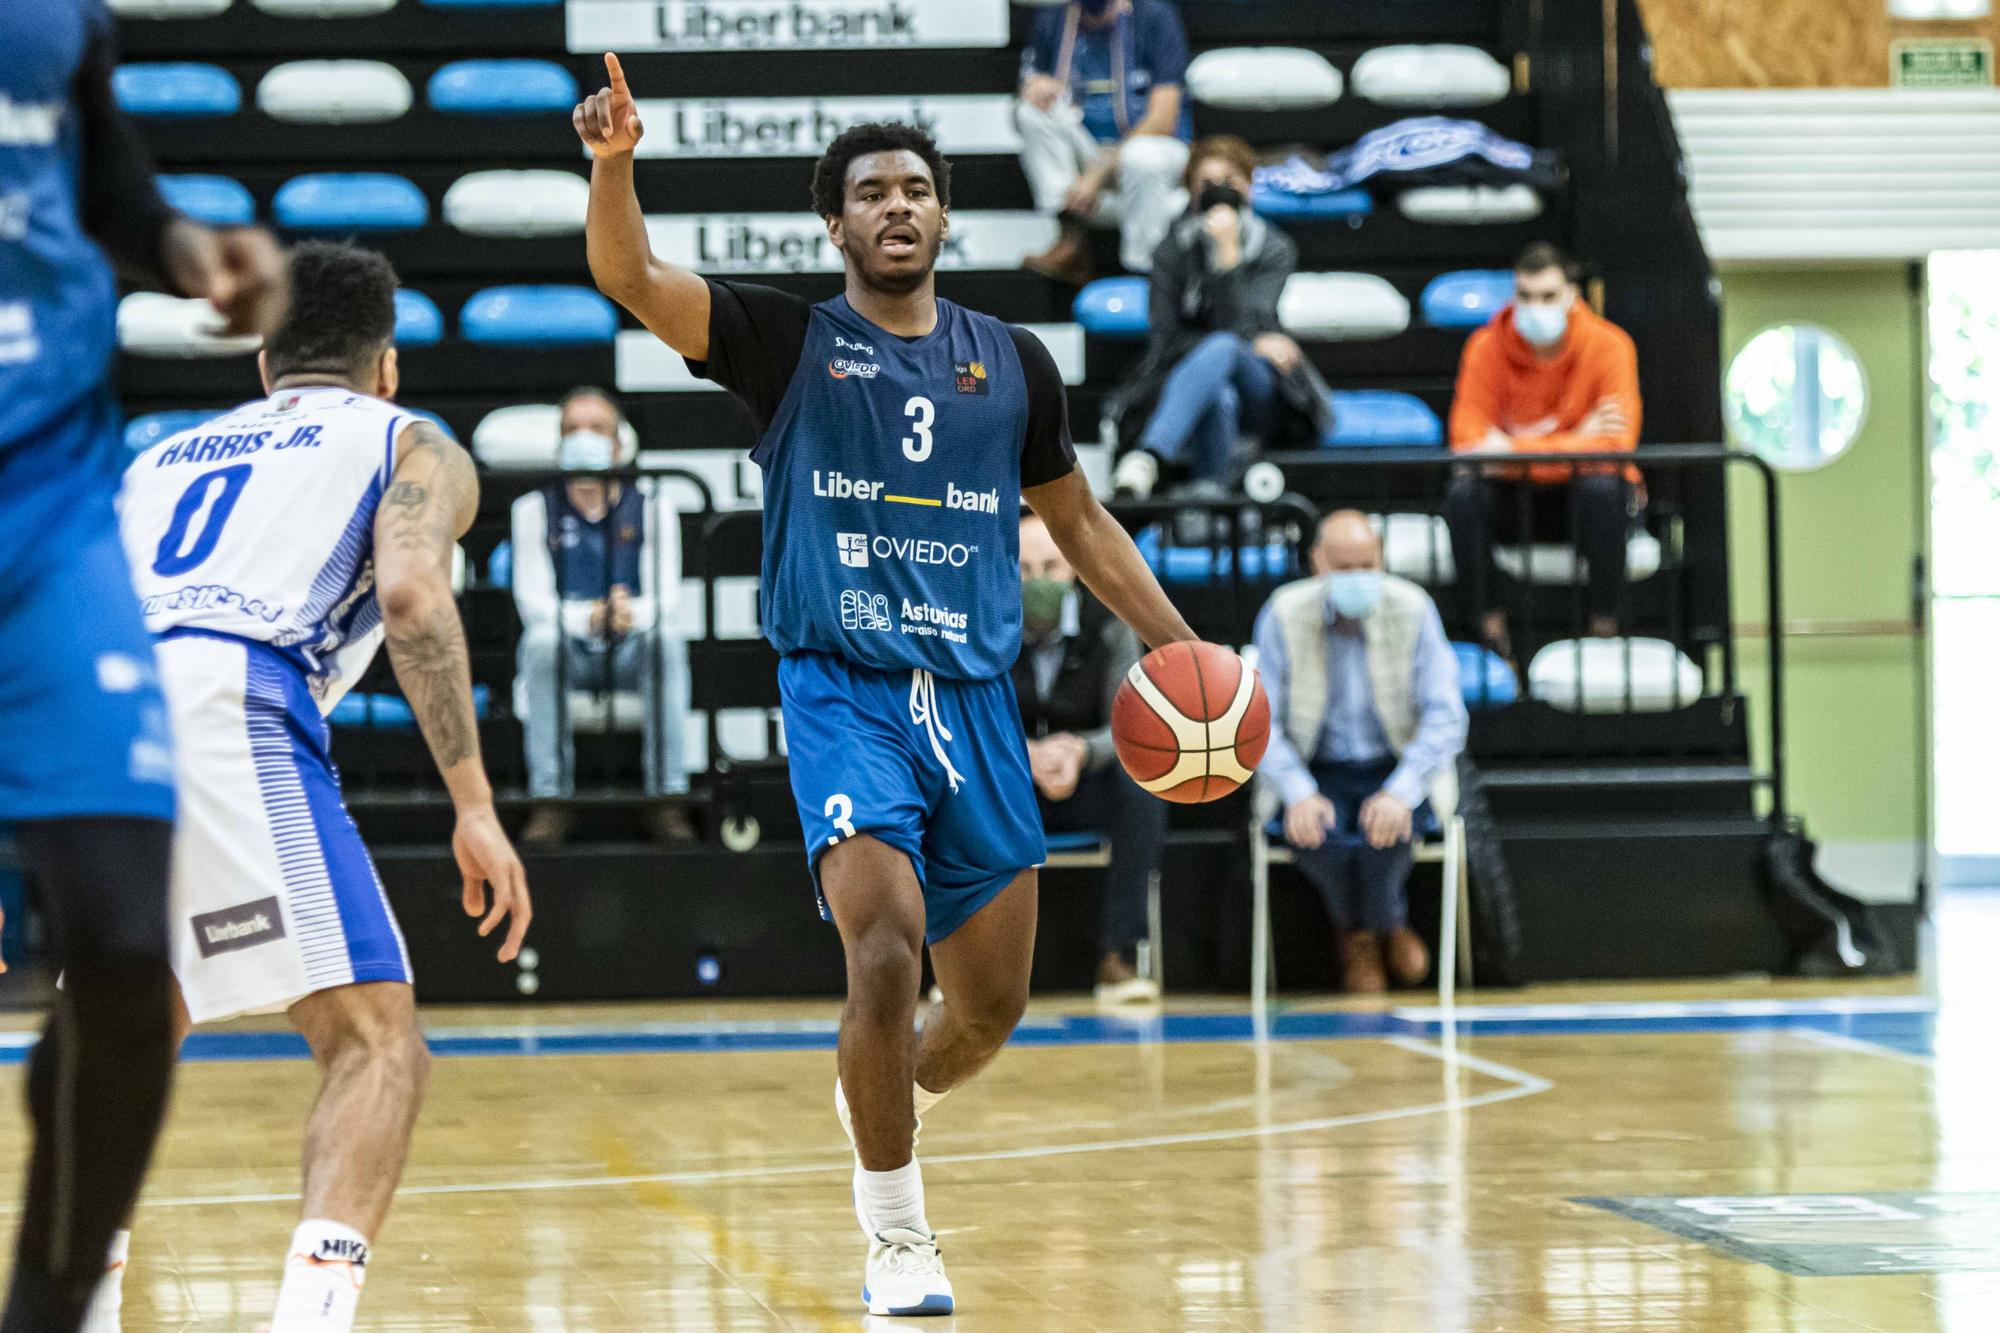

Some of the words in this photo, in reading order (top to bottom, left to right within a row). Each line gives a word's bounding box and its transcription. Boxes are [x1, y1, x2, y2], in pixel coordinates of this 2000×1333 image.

[674, 103, 939, 145] Liberbk
[156, 431, 273, 469] HARRIS
[273, 424, 324, 451] JR.
[902, 395, 936, 463] 3
[812, 470, 885, 501] Liber
[946, 481, 999, 515] bank
[152, 462, 254, 578] 0
[900, 597, 968, 630] Asturias
[824, 793, 857, 846] 3
[321, 1239, 368, 1262] NIK
